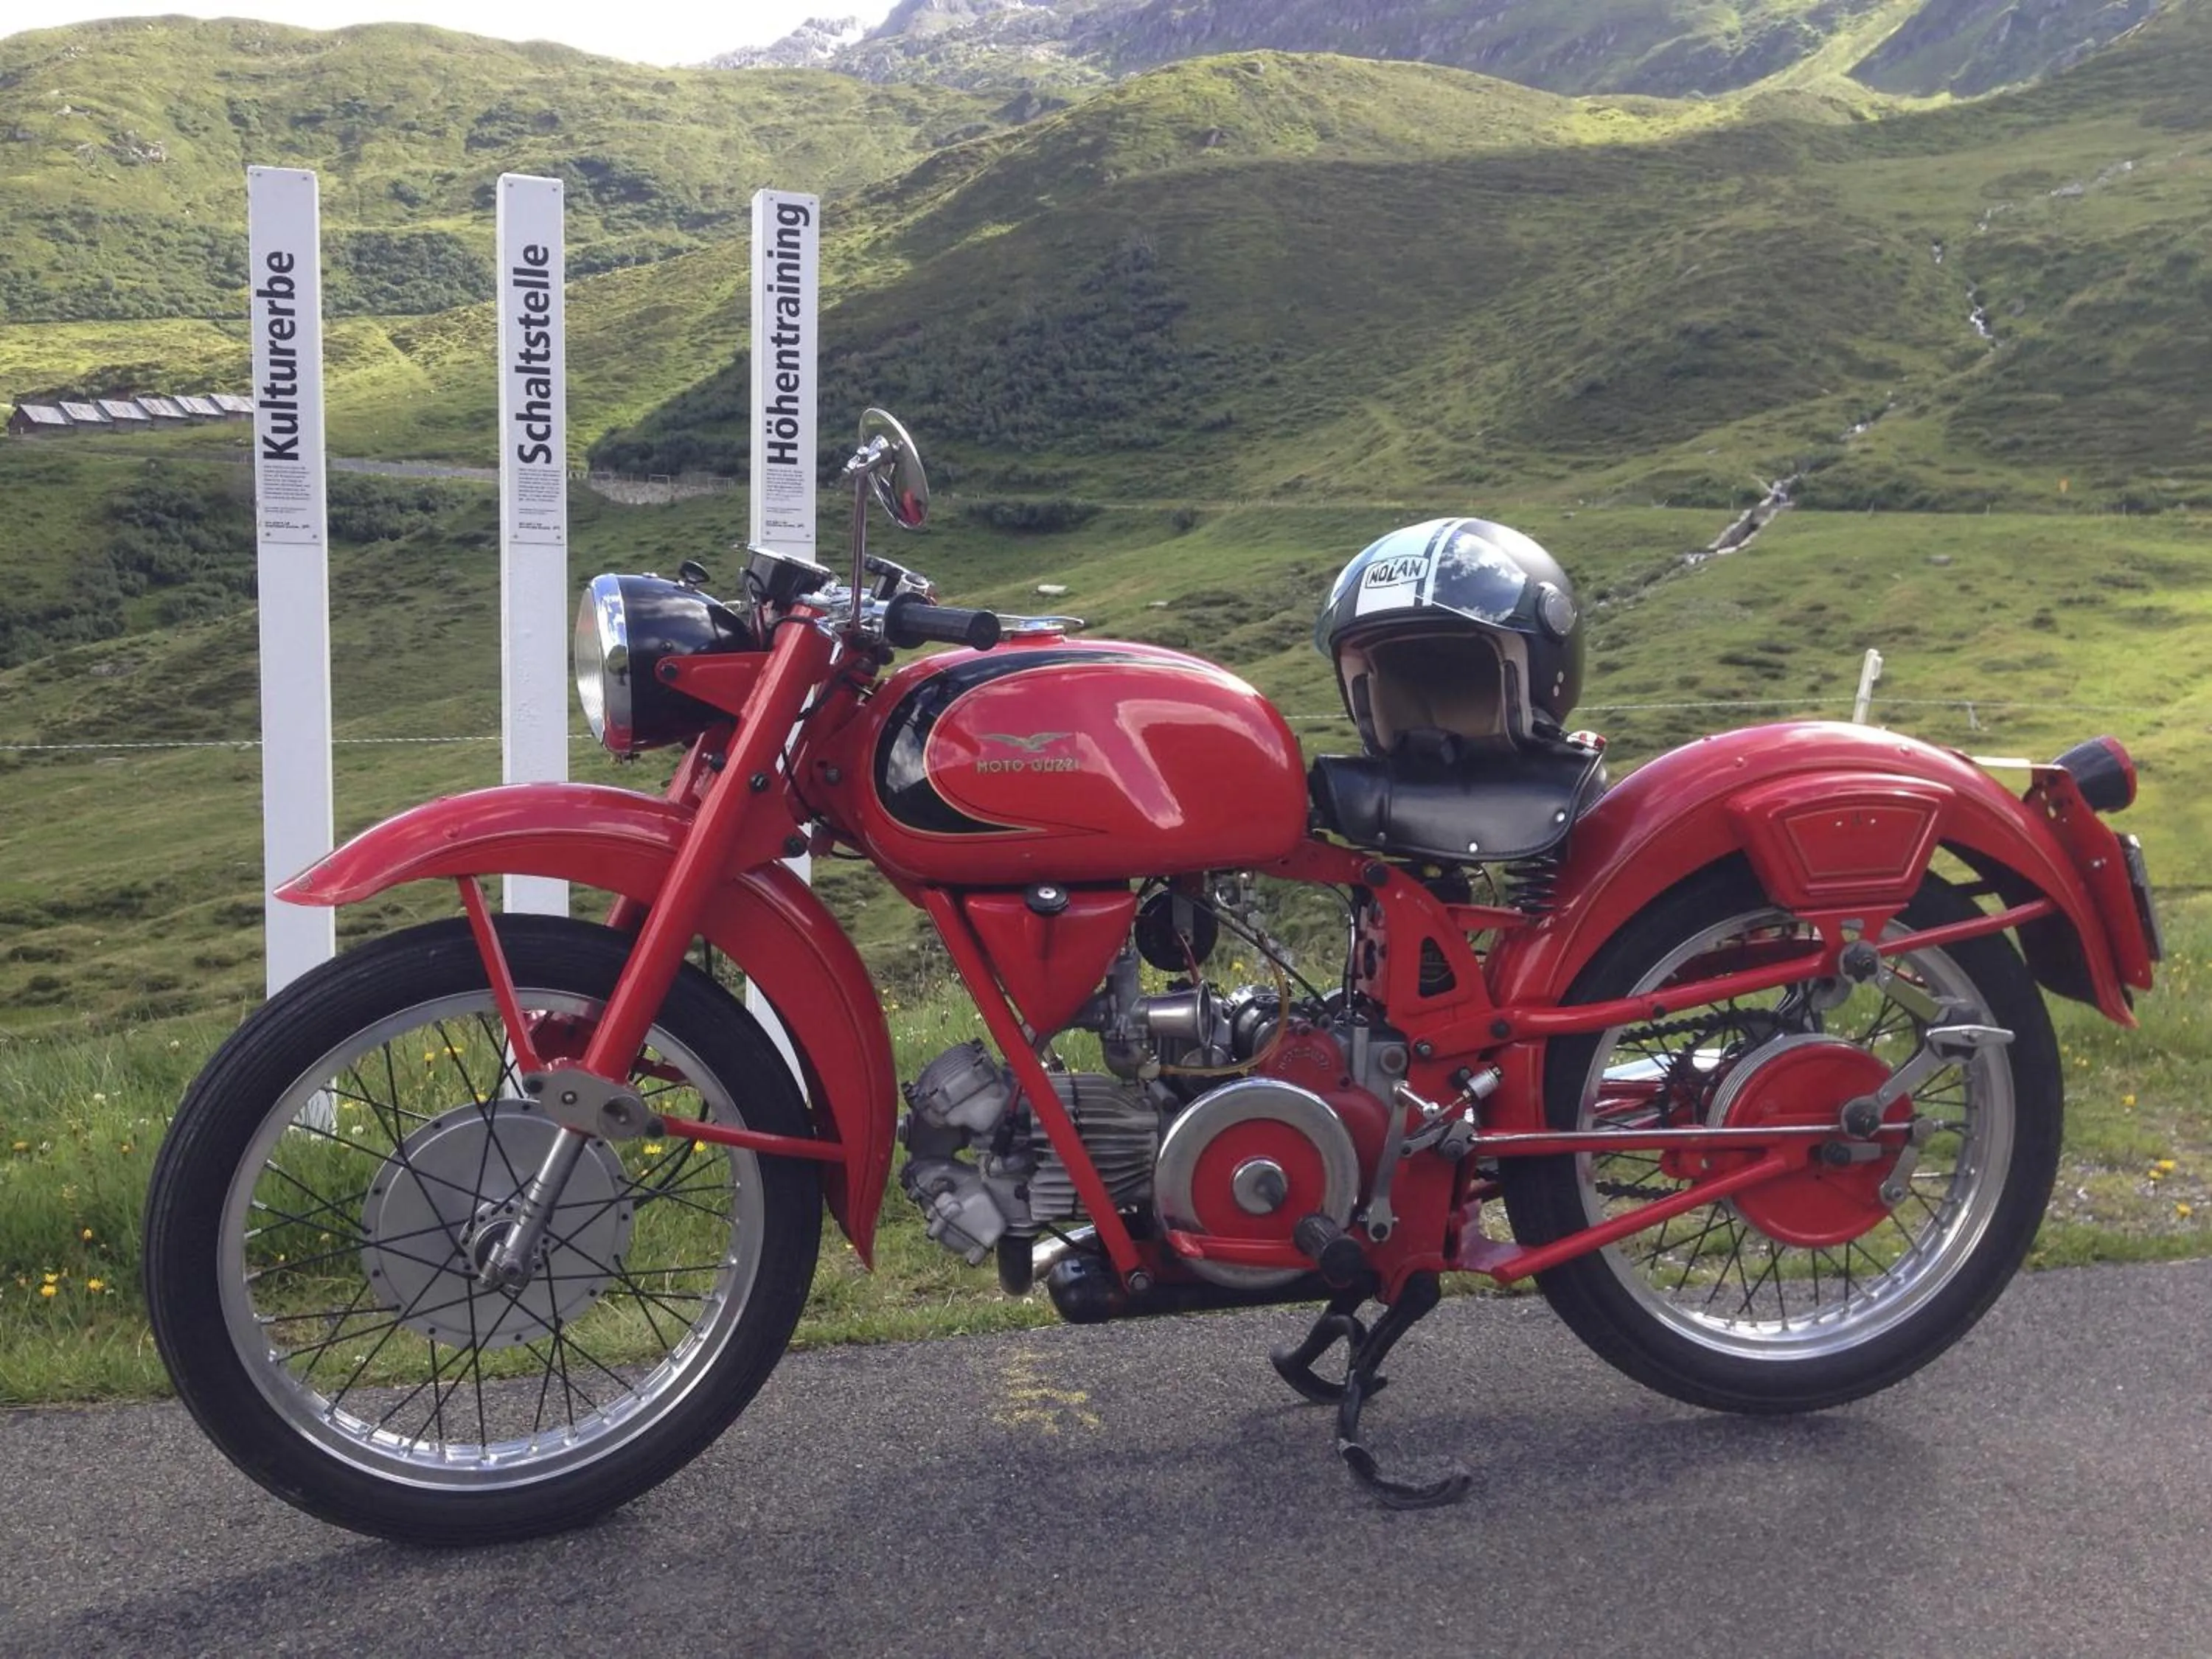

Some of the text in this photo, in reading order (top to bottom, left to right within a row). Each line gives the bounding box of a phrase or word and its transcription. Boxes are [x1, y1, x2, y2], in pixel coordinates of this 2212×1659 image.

[257, 251, 299, 461] Kulturerbe
[512, 244, 552, 465] Schaltstelle
[766, 203, 810, 465] Höhentraining
[1368, 558, 1422, 584] NOLAN
[977, 757, 1079, 773] MOTO GUZZI
